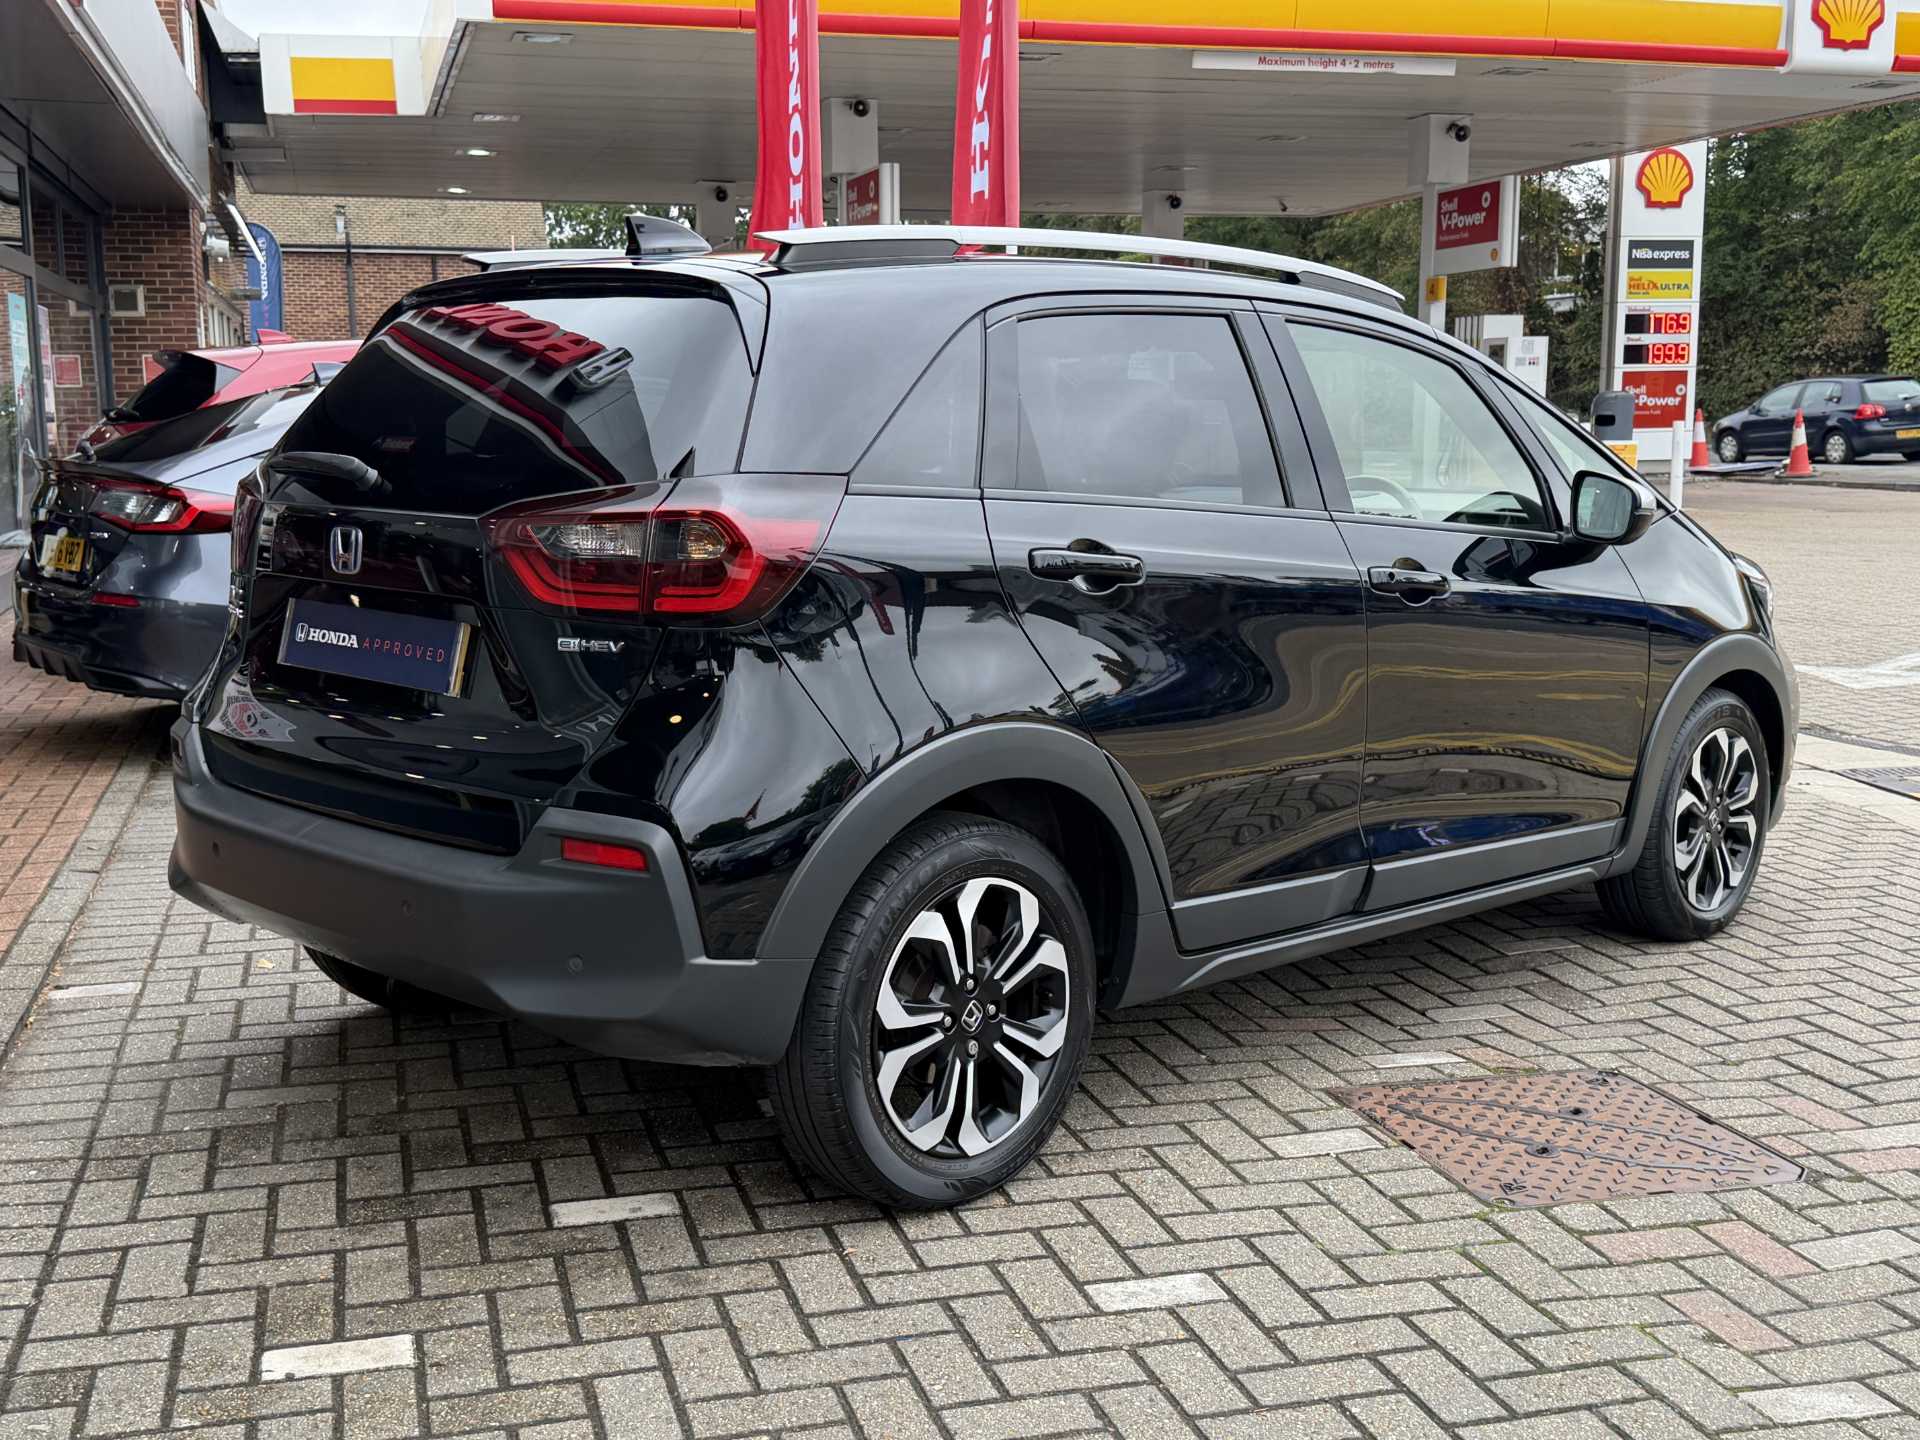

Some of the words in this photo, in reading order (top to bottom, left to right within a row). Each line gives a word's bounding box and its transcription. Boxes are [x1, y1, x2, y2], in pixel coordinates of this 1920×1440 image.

[1257, 55, 1306, 66] Maximum
[1308, 56, 1338, 69] height
[1363, 60, 1395, 70] metres
[1441, 198, 1458, 213] Shell
[1441, 211, 1487, 231] V-Power
[1660, 283, 1690, 291] ULTRA
[1649, 313, 1691, 334] 176.9
[1648, 343, 1689, 364] 199.9
[1634, 394, 1682, 407] -Power
[307, 627, 358, 648] HONDA
[362, 637, 445, 662] APPROVED
